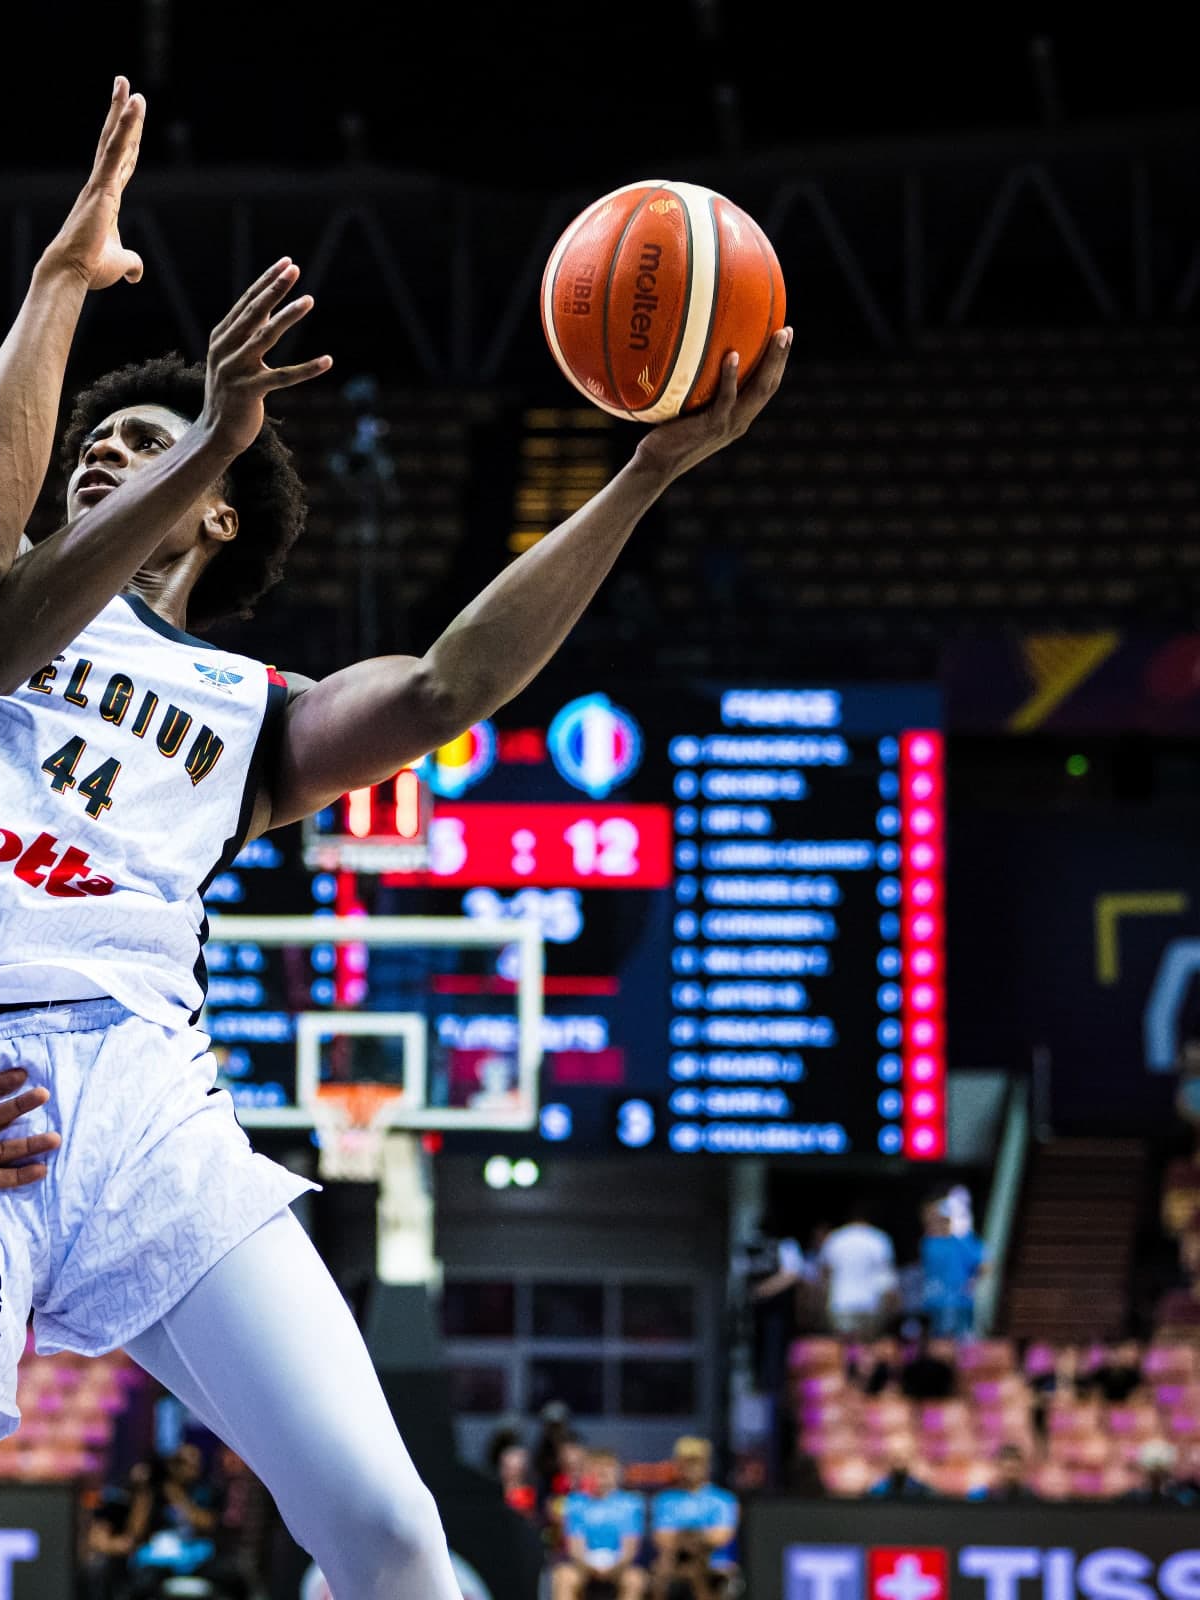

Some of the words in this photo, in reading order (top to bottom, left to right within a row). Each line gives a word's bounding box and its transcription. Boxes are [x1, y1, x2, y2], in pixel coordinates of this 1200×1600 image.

[572, 265, 596, 315] FIBA
[629, 243, 662, 351] molten
[27, 654, 225, 787] ELGIUM
[41, 735, 122, 820] 44
[565, 816, 640, 877] 12
